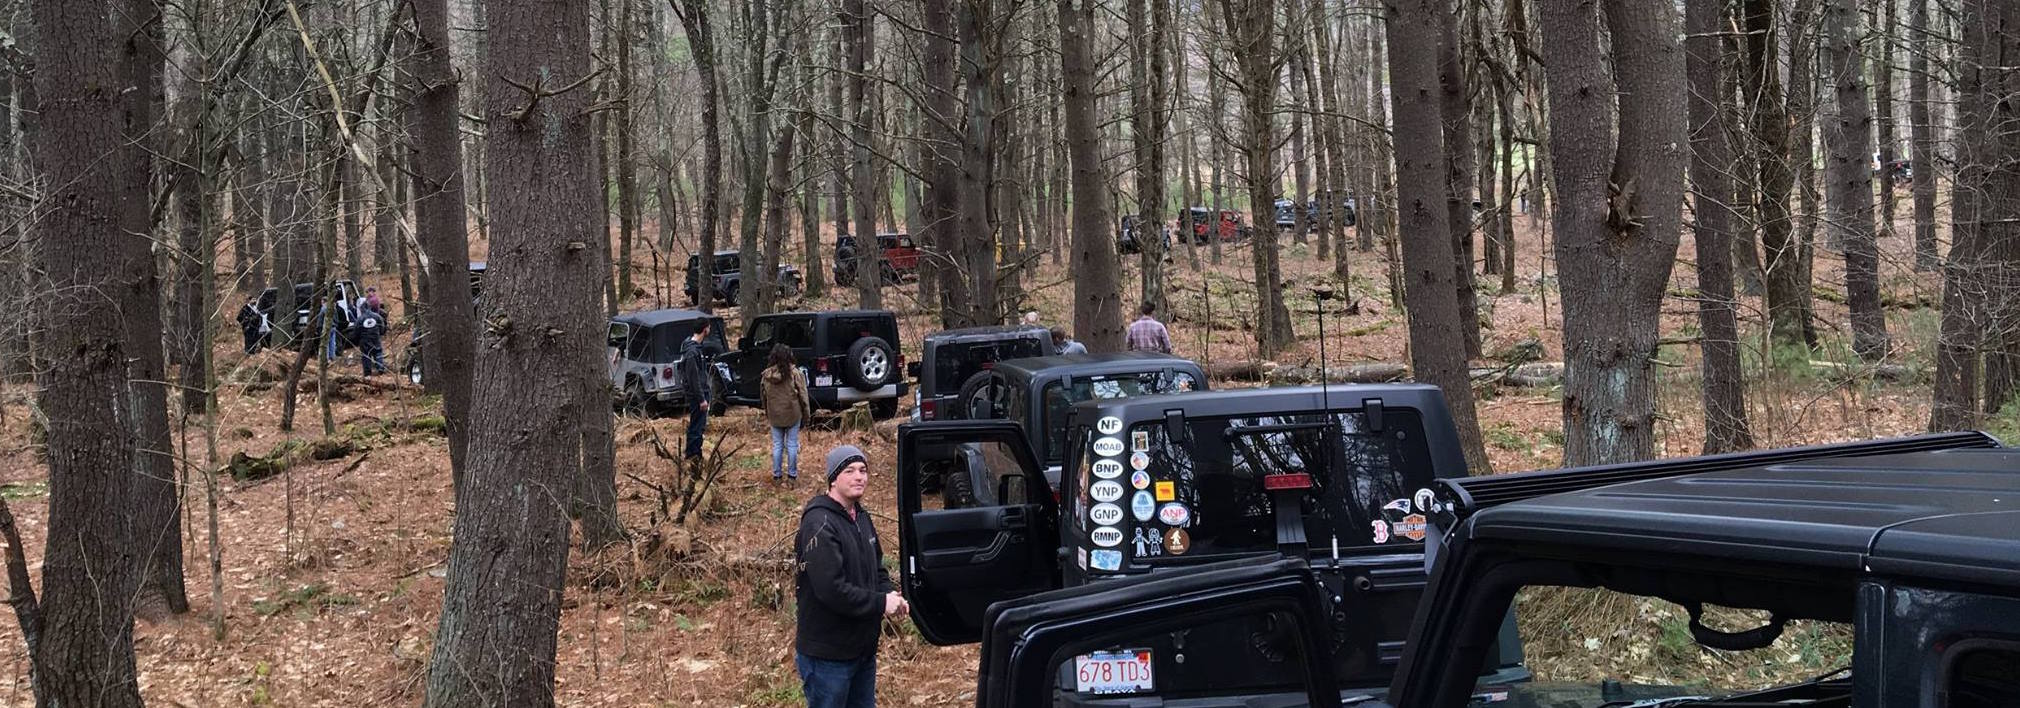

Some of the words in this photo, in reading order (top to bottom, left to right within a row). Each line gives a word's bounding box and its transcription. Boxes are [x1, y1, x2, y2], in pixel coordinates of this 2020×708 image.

[1100, 420, 1119, 430] NF
[1095, 442, 1122, 451] MOAB
[1095, 464, 1120, 473] BNP
[1094, 487, 1119, 497] YNP
[1094, 509, 1118, 519] GNP
[1162, 508, 1186, 518] ANP
[1372, 520, 1389, 543] B
[1094, 532, 1121, 542] RMNP
[1080, 662, 1112, 682] 678
[1117, 661, 1149, 682] TD3
